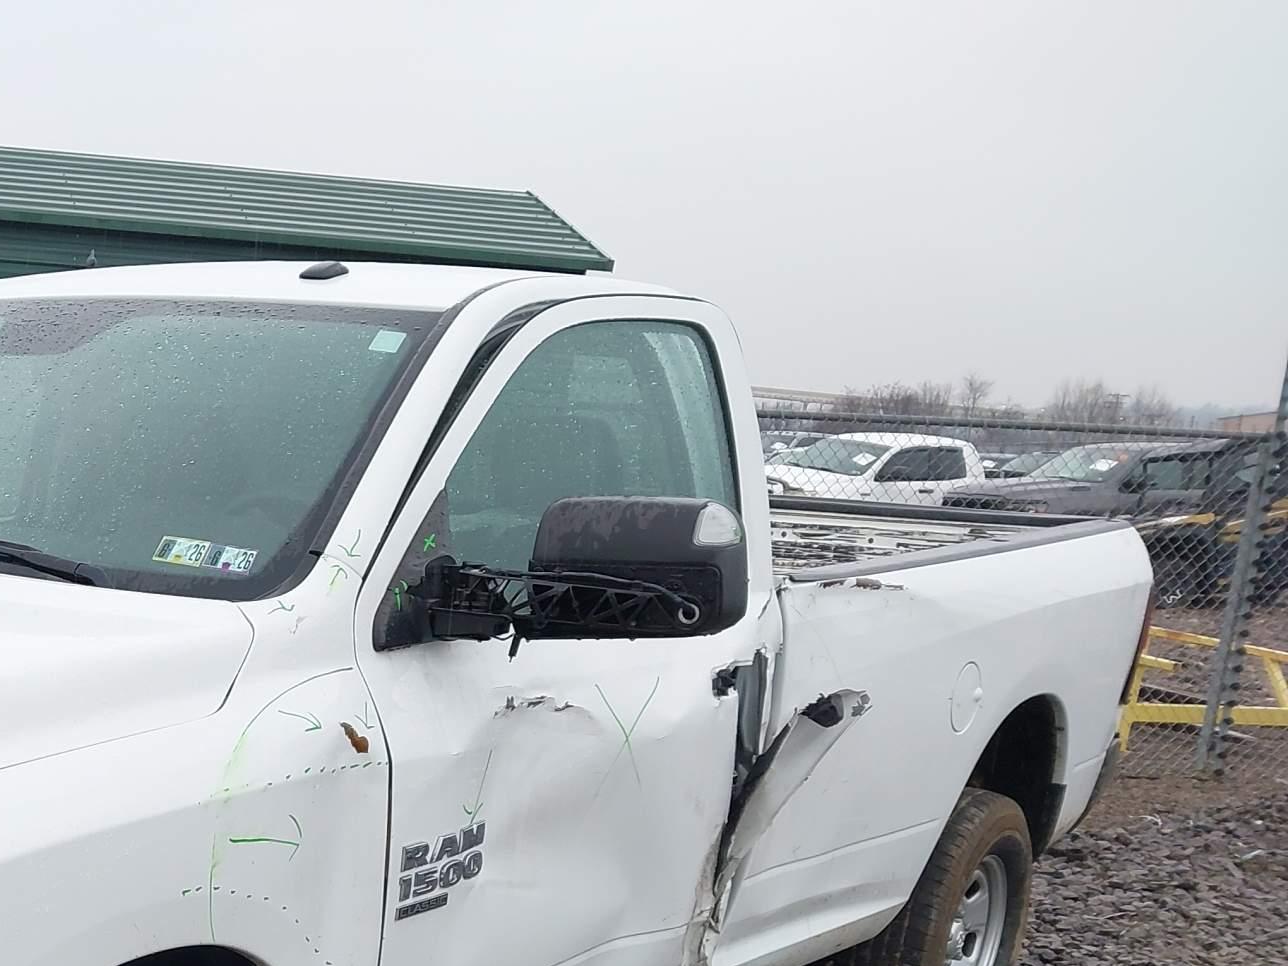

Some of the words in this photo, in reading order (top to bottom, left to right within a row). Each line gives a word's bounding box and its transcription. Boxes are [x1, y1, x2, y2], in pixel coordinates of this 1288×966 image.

[188, 543, 206, 562] 26
[237, 551, 255, 570] 26
[400, 820, 487, 872] RAM
[399, 850, 483, 902] 1500
[398, 894, 448, 920] CLASSIC
